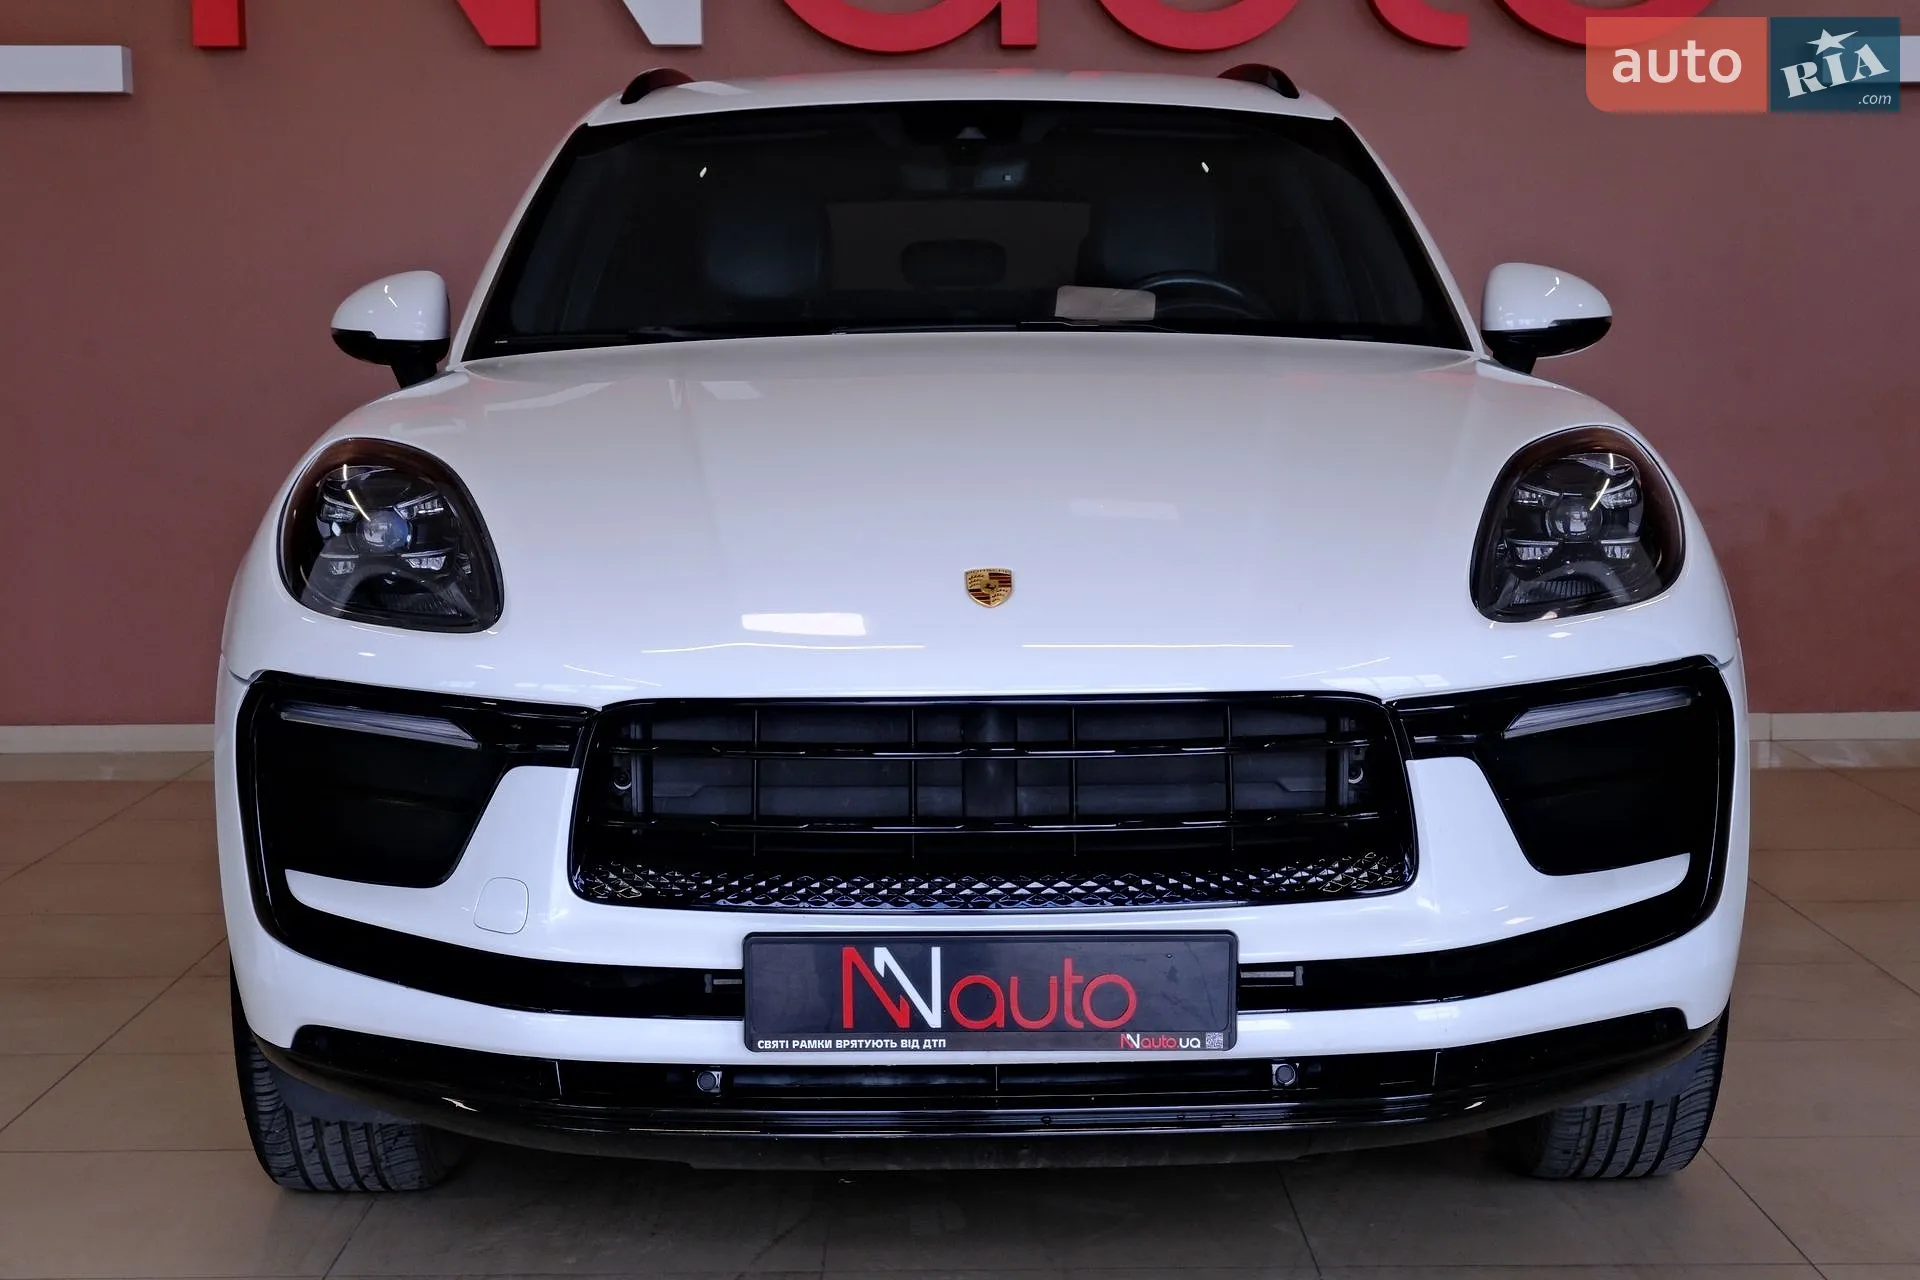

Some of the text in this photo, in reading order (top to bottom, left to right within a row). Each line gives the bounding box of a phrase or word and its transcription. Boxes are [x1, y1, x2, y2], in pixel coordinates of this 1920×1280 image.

[757, 1038, 947, 1049] СВЯТІ РАМКИ ВРЯТУЮТЬ ВІД ДТП
